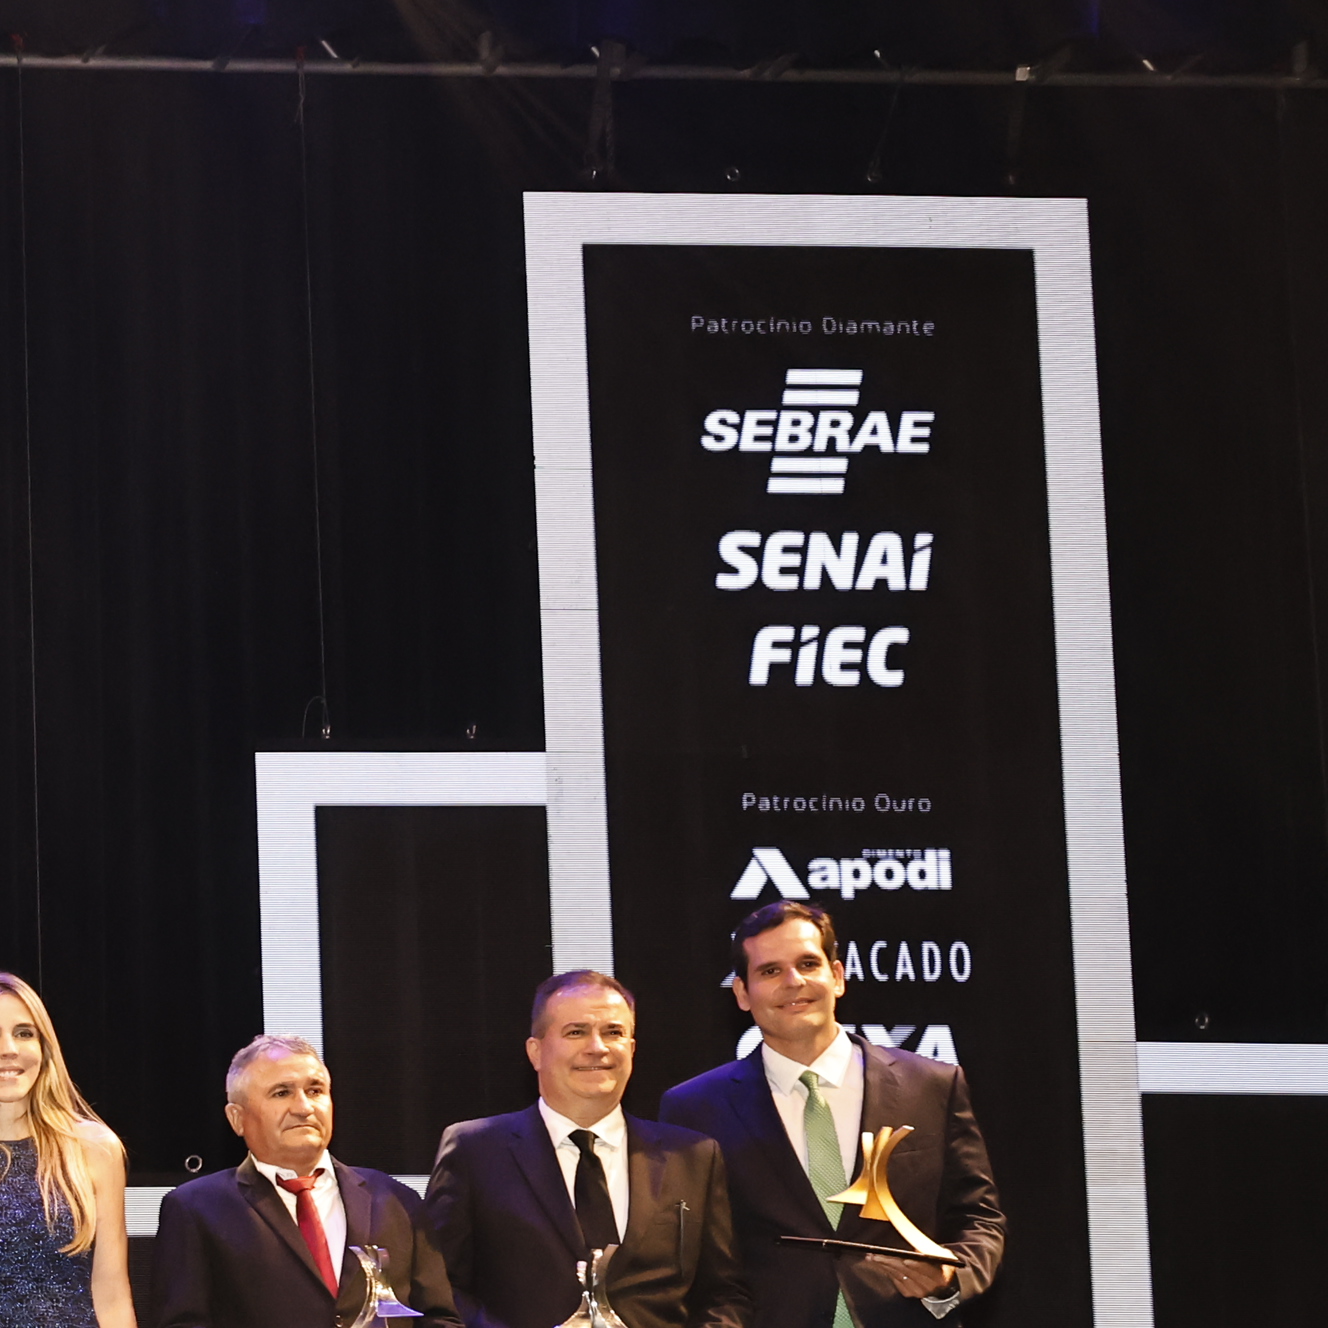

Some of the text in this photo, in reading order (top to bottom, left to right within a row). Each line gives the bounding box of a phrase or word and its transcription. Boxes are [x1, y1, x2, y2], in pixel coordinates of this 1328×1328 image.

[690, 315, 936, 336] Patrocínio Diamante
[700, 409, 935, 454] SEBRAE
[742, 792, 932, 813] Patrocínio Ouro
[808, 848, 953, 901] apodi
[845, 939, 973, 984] ACADO
